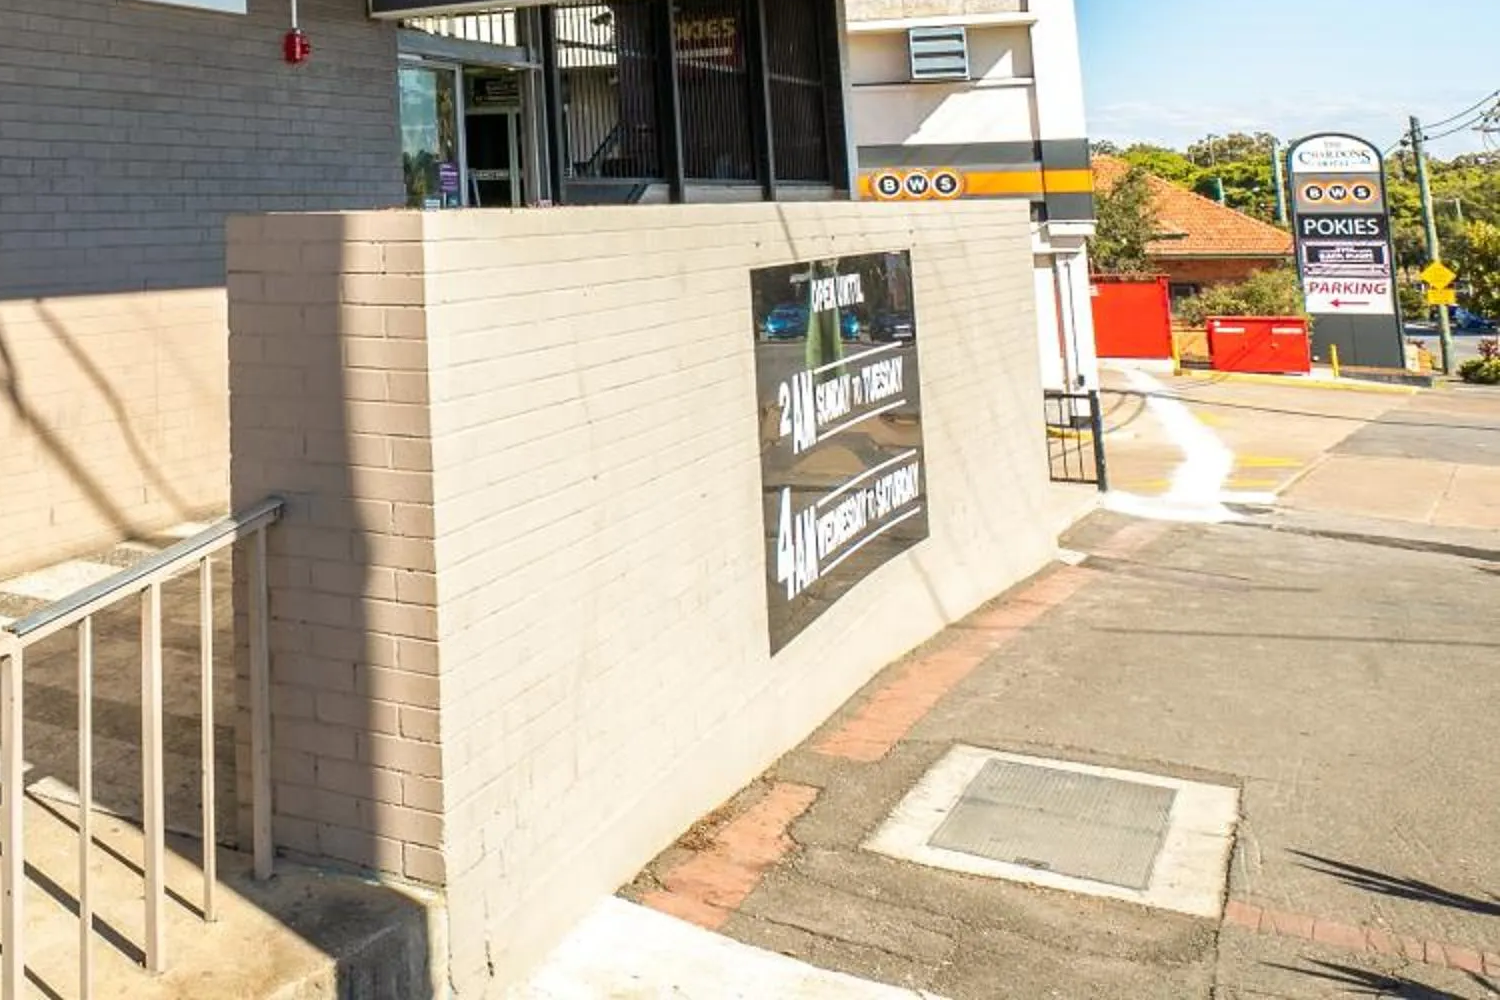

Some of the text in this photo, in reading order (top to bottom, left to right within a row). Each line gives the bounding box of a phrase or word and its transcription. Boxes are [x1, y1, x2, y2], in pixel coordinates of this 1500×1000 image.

[879, 175, 956, 194] BWS
[1307, 186, 1369, 199] BWS
[1303, 218, 1380, 236] POKIES
[811, 278, 836, 313] OPEN
[1308, 281, 1387, 295] PARKING
[815, 373, 851, 427] SUNDAY
[861, 355, 904, 405] TUESDAY
